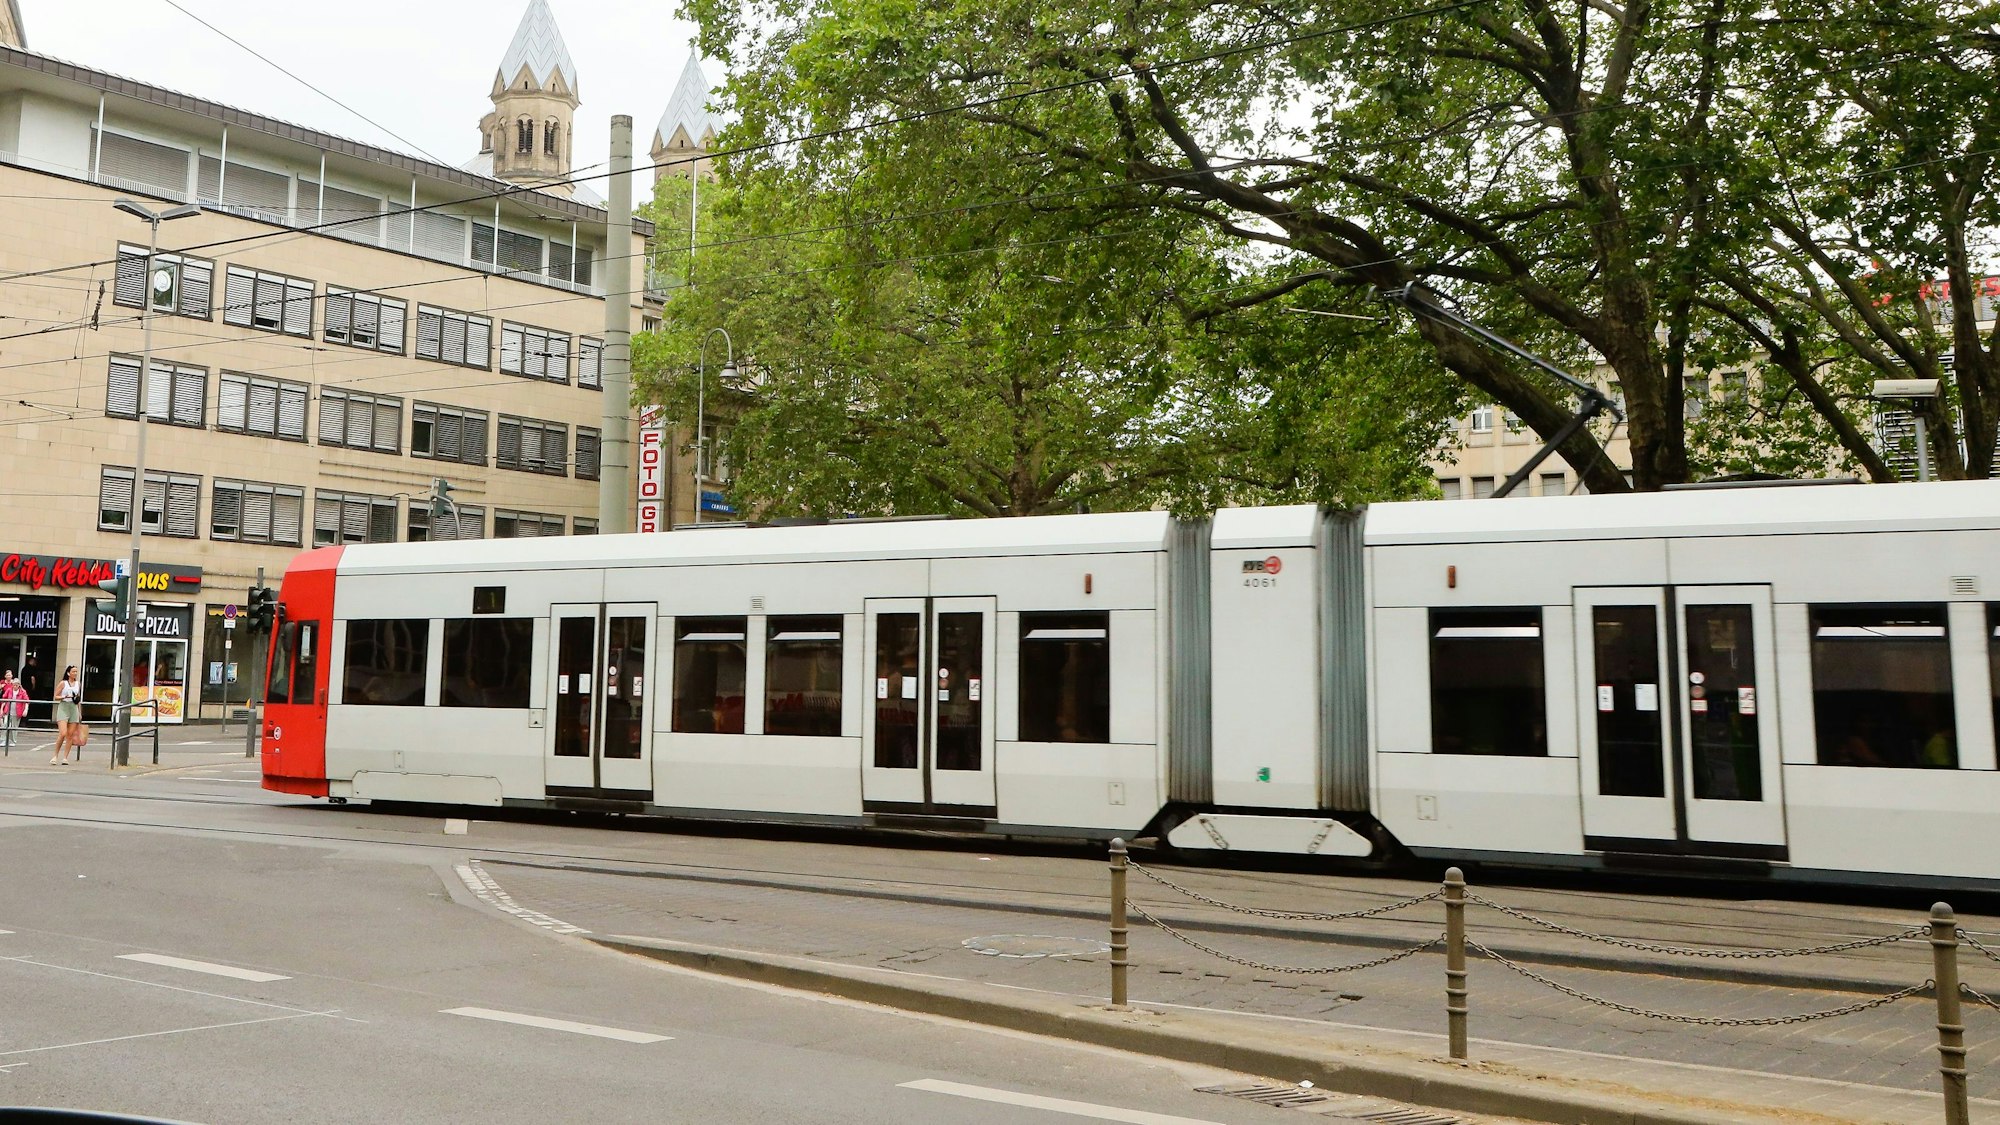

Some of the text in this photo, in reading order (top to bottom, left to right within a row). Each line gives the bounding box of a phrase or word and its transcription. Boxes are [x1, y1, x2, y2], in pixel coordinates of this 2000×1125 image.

[1, 554, 170, 591] City Kebab aus
[1243, 578, 1276, 588] 4061
[19, 611, 57, 629] FALAFEL
[146, 616, 180, 635] PIZZA
